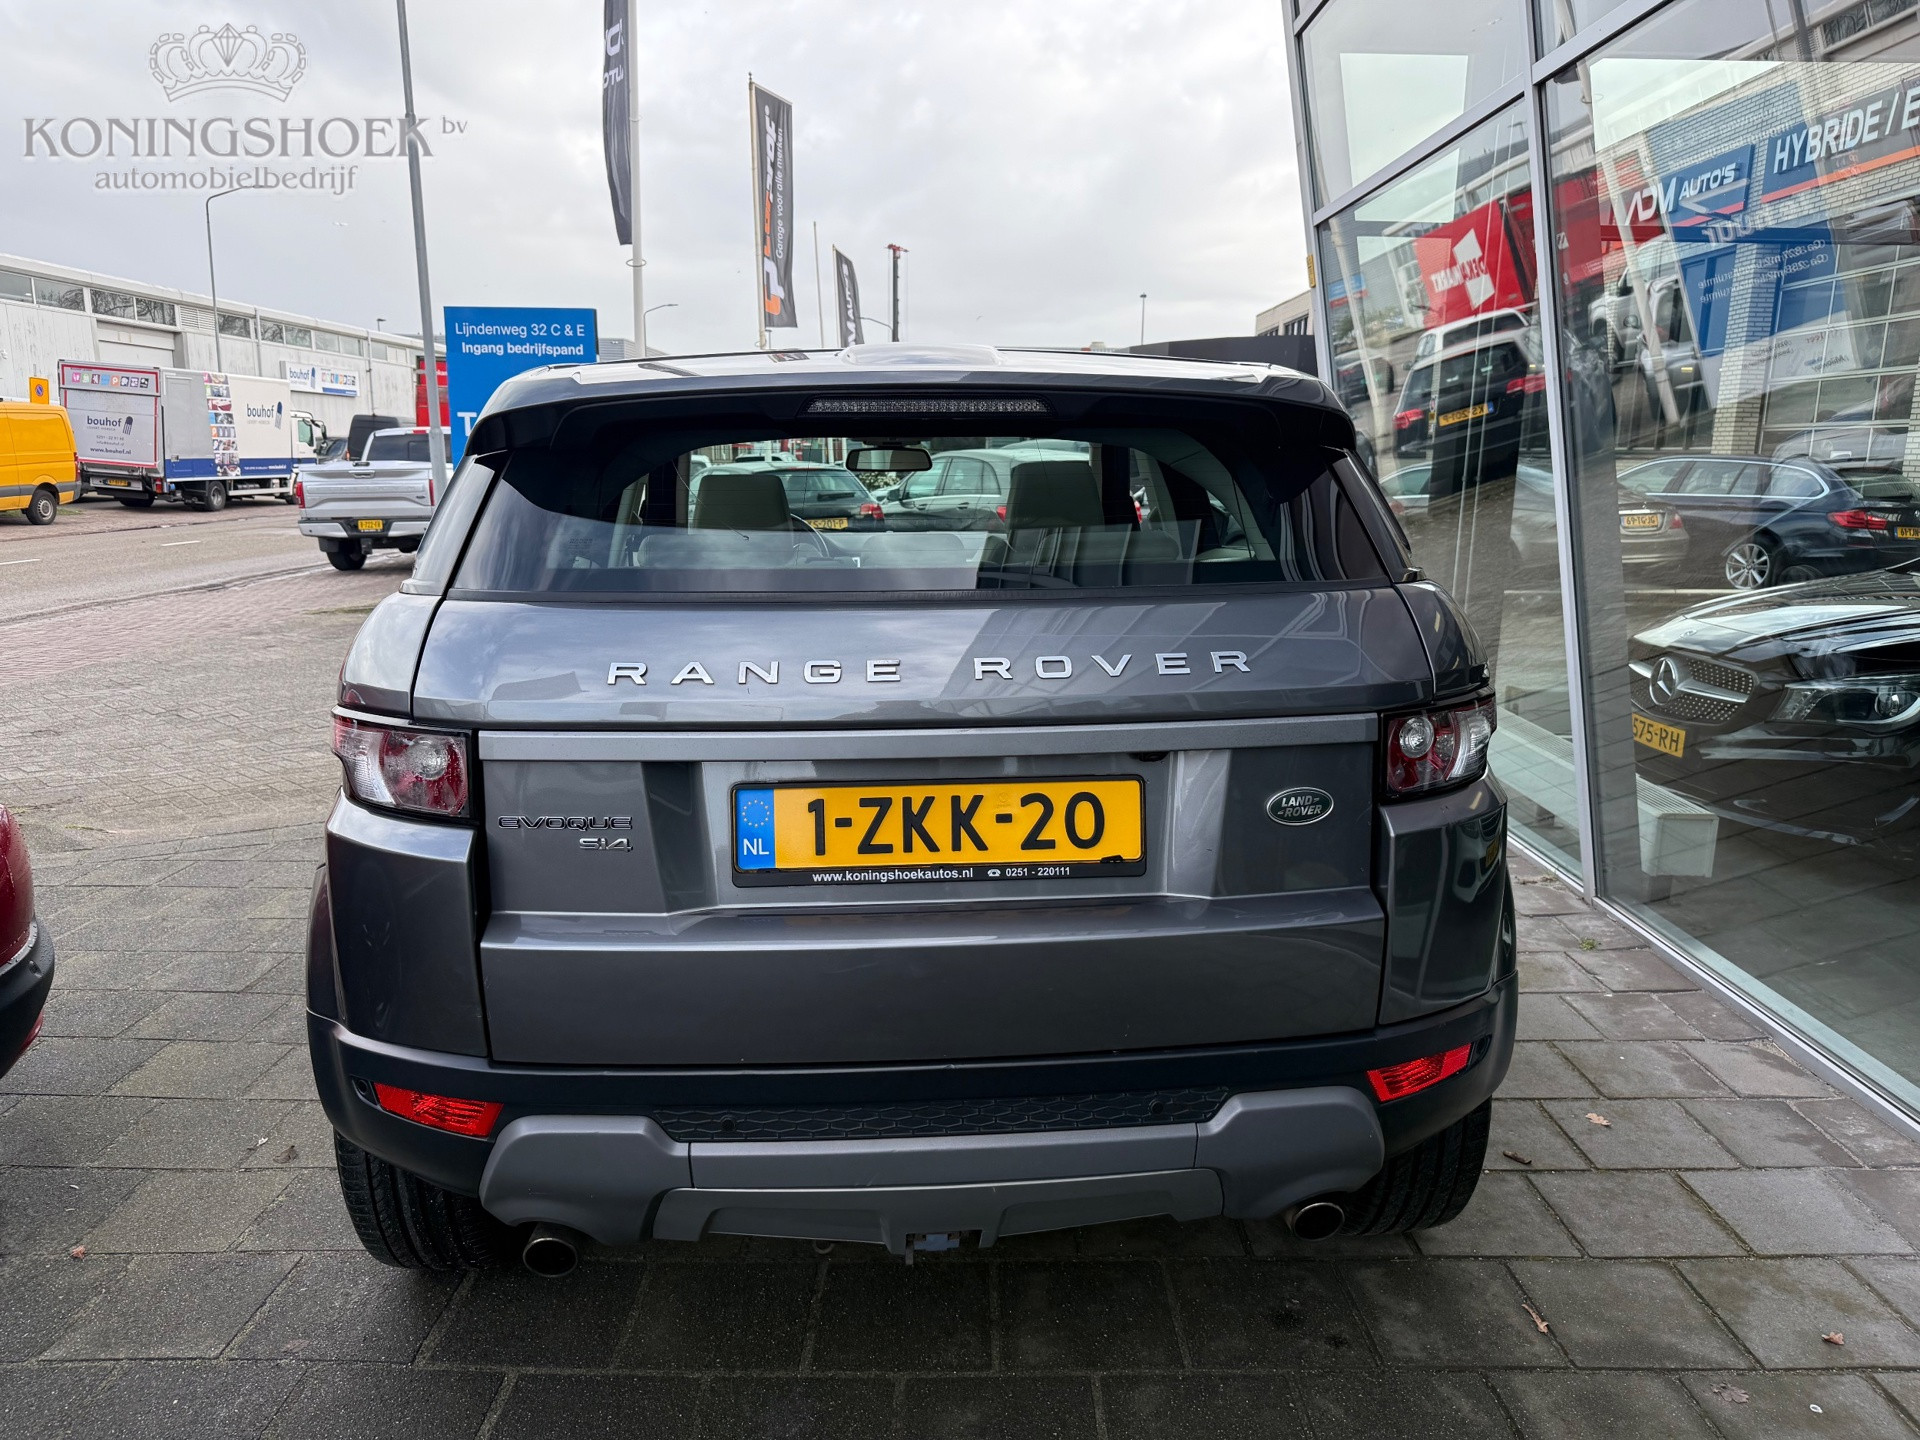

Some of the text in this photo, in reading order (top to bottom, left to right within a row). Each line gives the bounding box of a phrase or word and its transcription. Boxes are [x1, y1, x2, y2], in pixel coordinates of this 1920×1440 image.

[1773, 99, 1883, 174] HYBRIDE
[775, 128, 785, 258] Garage voor alle merken
[1625, 162, 1736, 226] ADM AUTO'S
[455, 323, 585, 338] Lijndenweg 32 C & E
[462, 342, 584, 357] Ingang bedrijfspand
[289, 367, 310, 380] bouhof
[246, 403, 275, 418] bouhof
[87, 415, 122, 427] bouhof
[90, 447, 132, 455] www.bouhof.nl
[606, 650, 1251, 685] RANGE ROVER
[1632, 716, 1680, 752] 575-RH
[1281, 795, 1313, 808] LAND
[1284, 804, 1322, 818] ROVER
[498, 815, 632, 832] EVOQUE
[807, 791, 1105, 856] 1-ZKK-20
[742, 837, 770, 856] NL
[812, 867, 974, 883] www.koningshoekautos.nl
[1005, 867, 1029, 877] 0251
[1037, 866, 1070, 877] 220111
